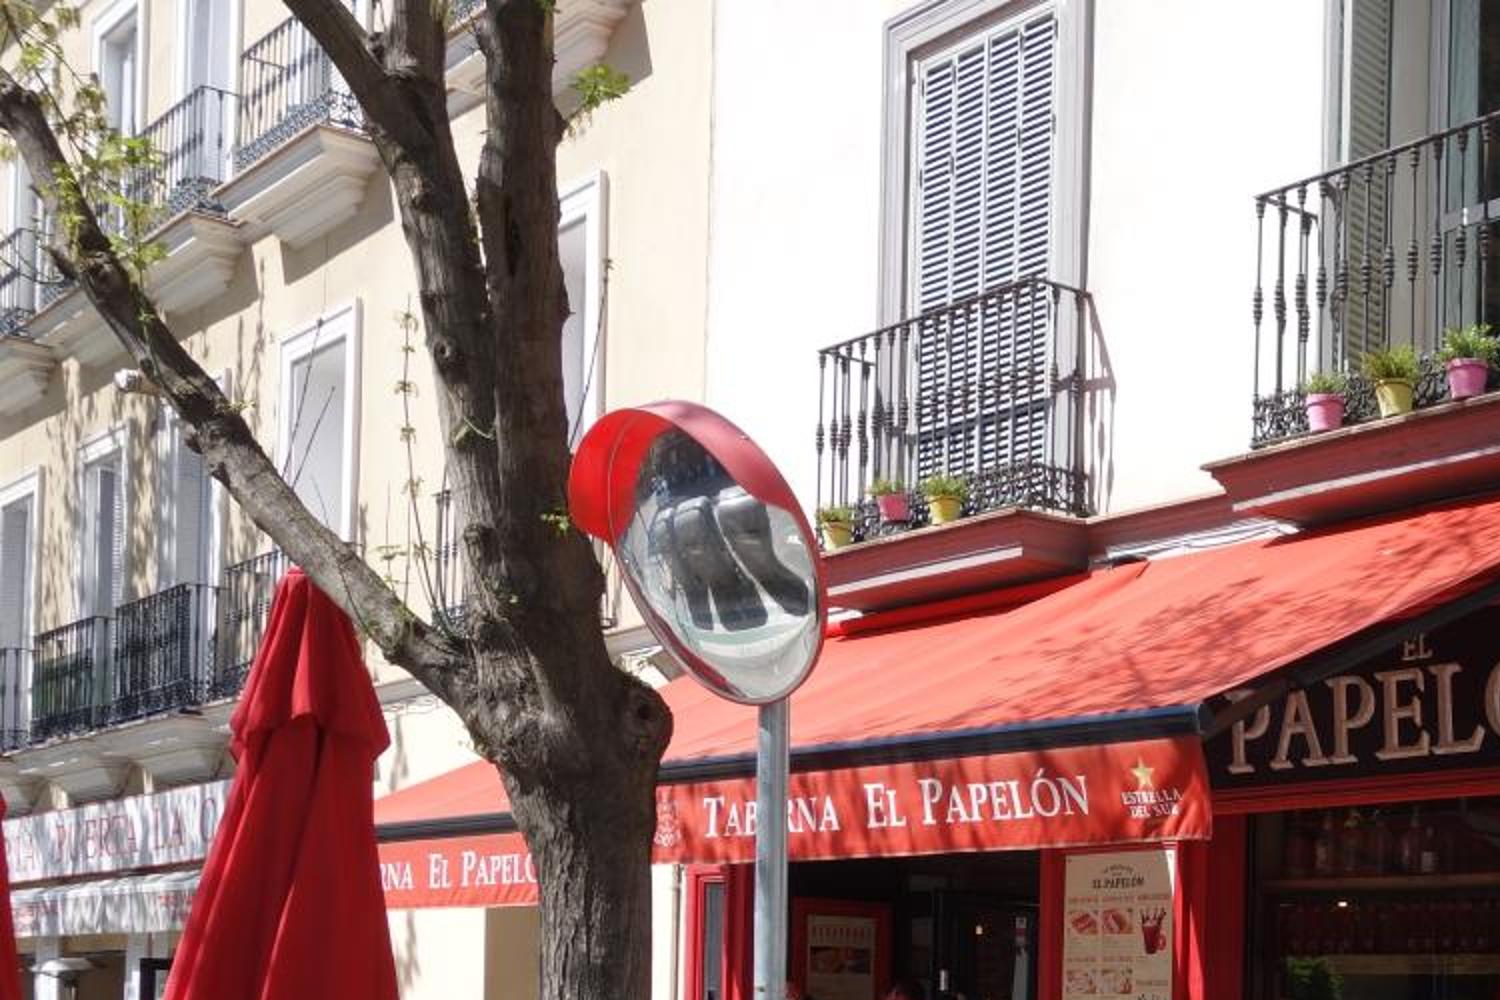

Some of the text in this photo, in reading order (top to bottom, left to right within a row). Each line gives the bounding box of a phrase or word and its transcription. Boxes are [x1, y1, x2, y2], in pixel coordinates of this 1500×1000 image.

[1402, 633, 1433, 661] EL
[704, 768, 1088, 839] TABRNA EL PAPELÓN
[1121, 788, 1183, 805] ESTRELLA
[428, 853, 451, 889] EL
